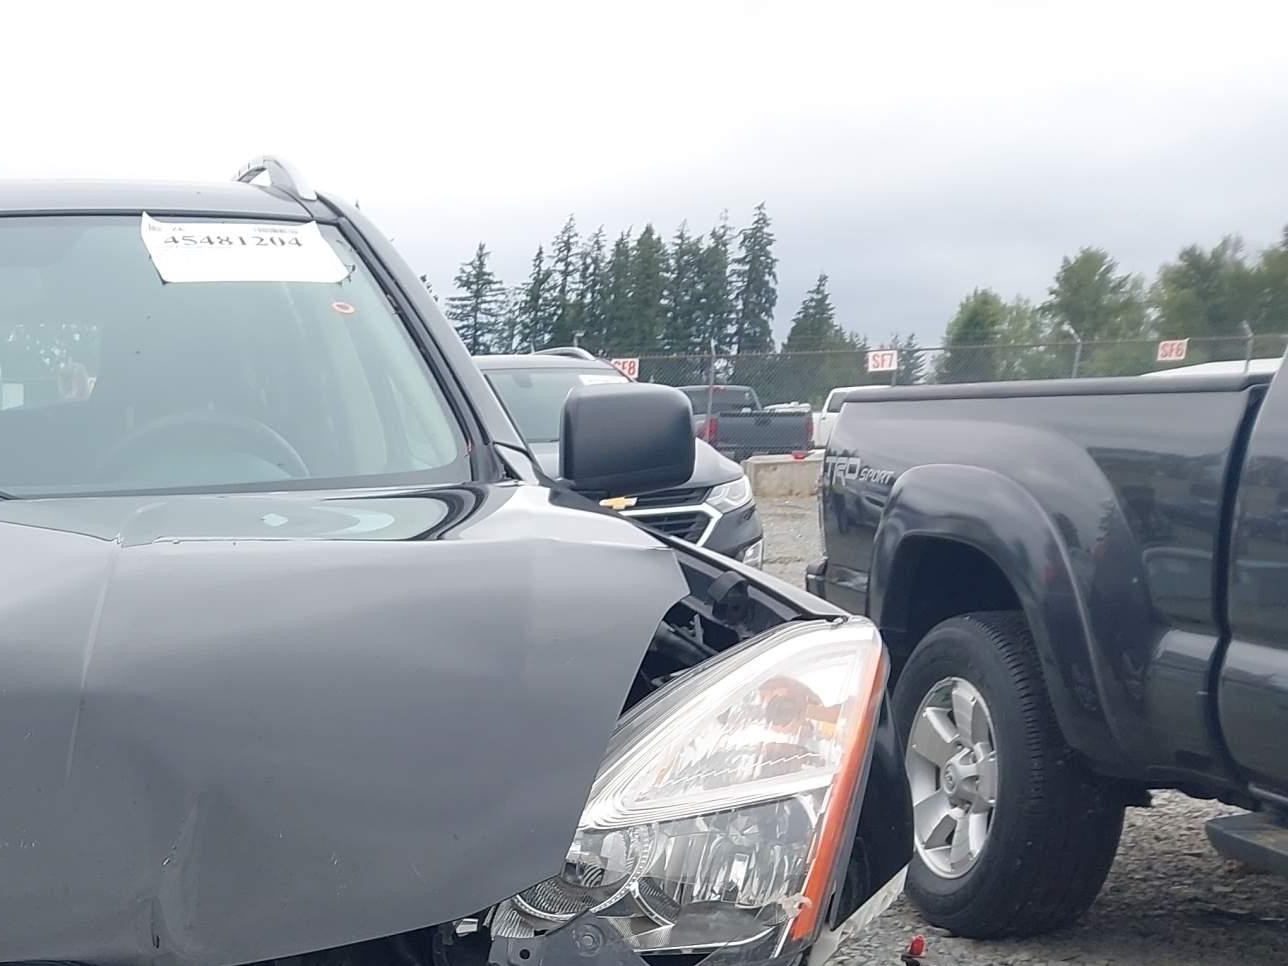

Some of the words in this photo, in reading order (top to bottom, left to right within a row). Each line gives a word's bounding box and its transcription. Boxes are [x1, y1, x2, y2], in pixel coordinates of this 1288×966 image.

[163, 235, 303, 247] 45481204
[1160, 342, 1185, 358] SF6
[872, 353, 893, 369] SF7
[825, 456, 861, 486] TRD
[859, 467, 894, 485] SPORT
